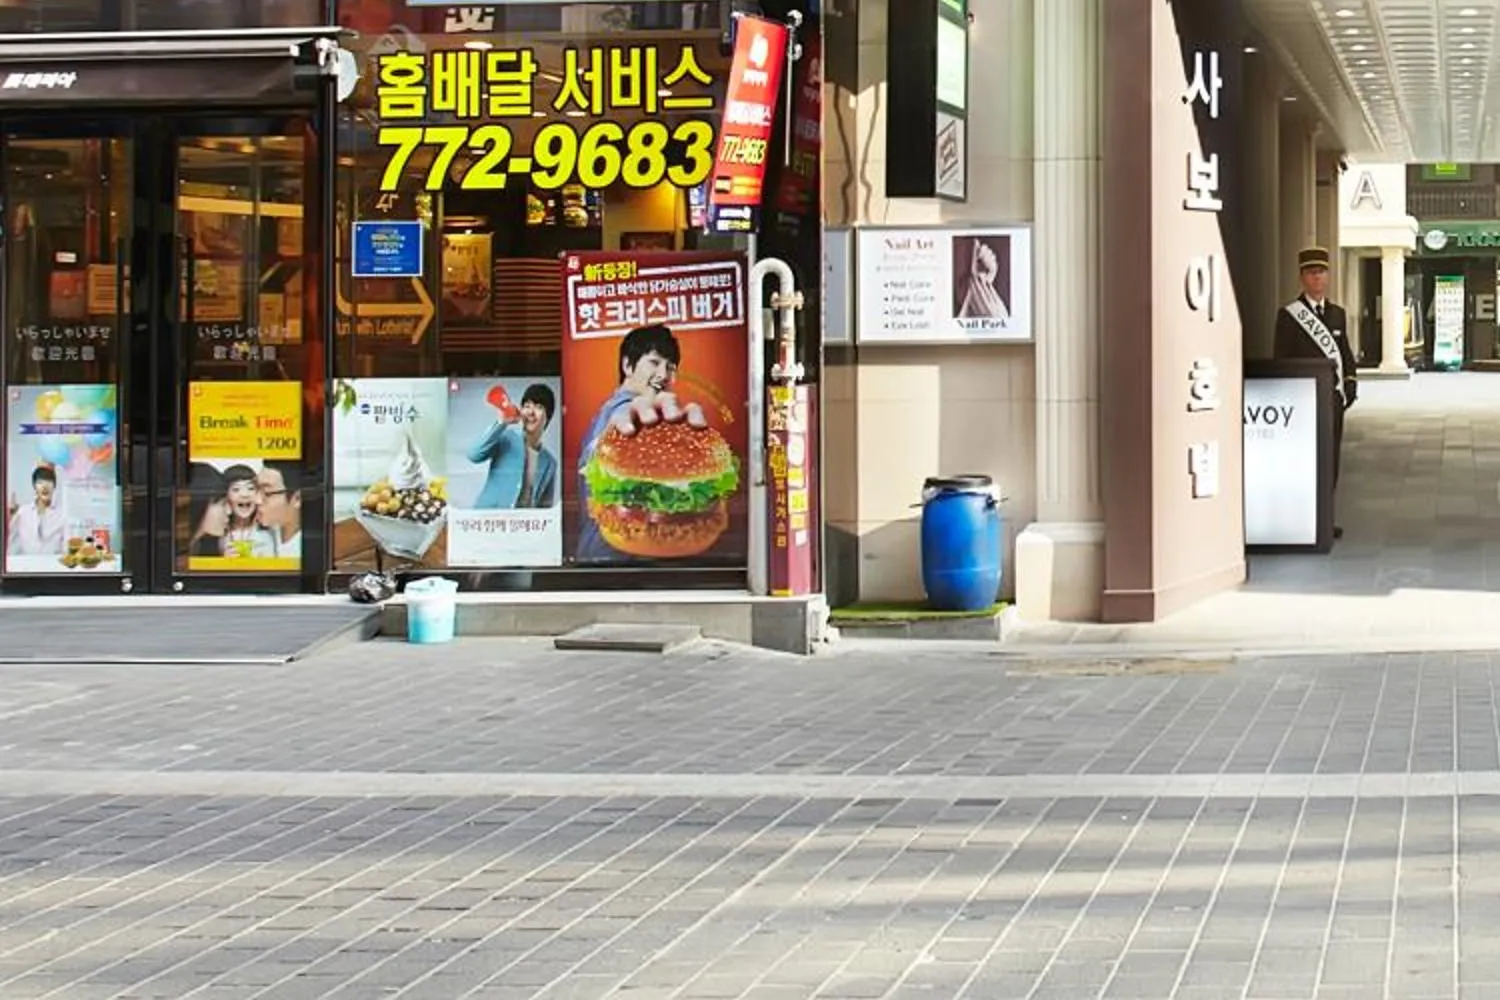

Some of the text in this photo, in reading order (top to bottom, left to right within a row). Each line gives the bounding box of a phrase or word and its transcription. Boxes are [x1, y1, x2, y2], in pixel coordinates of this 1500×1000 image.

[377, 45, 714, 119] 홈배달 서비스
[377, 118, 716, 194] 772-9683
[604, 296, 687, 328] 크리스피
[692, 291, 733, 319] 버거
[1298, 308, 1337, 355] SAVOY
[199, 414, 248, 429] Break
[1243, 404, 1295, 428] VOY
